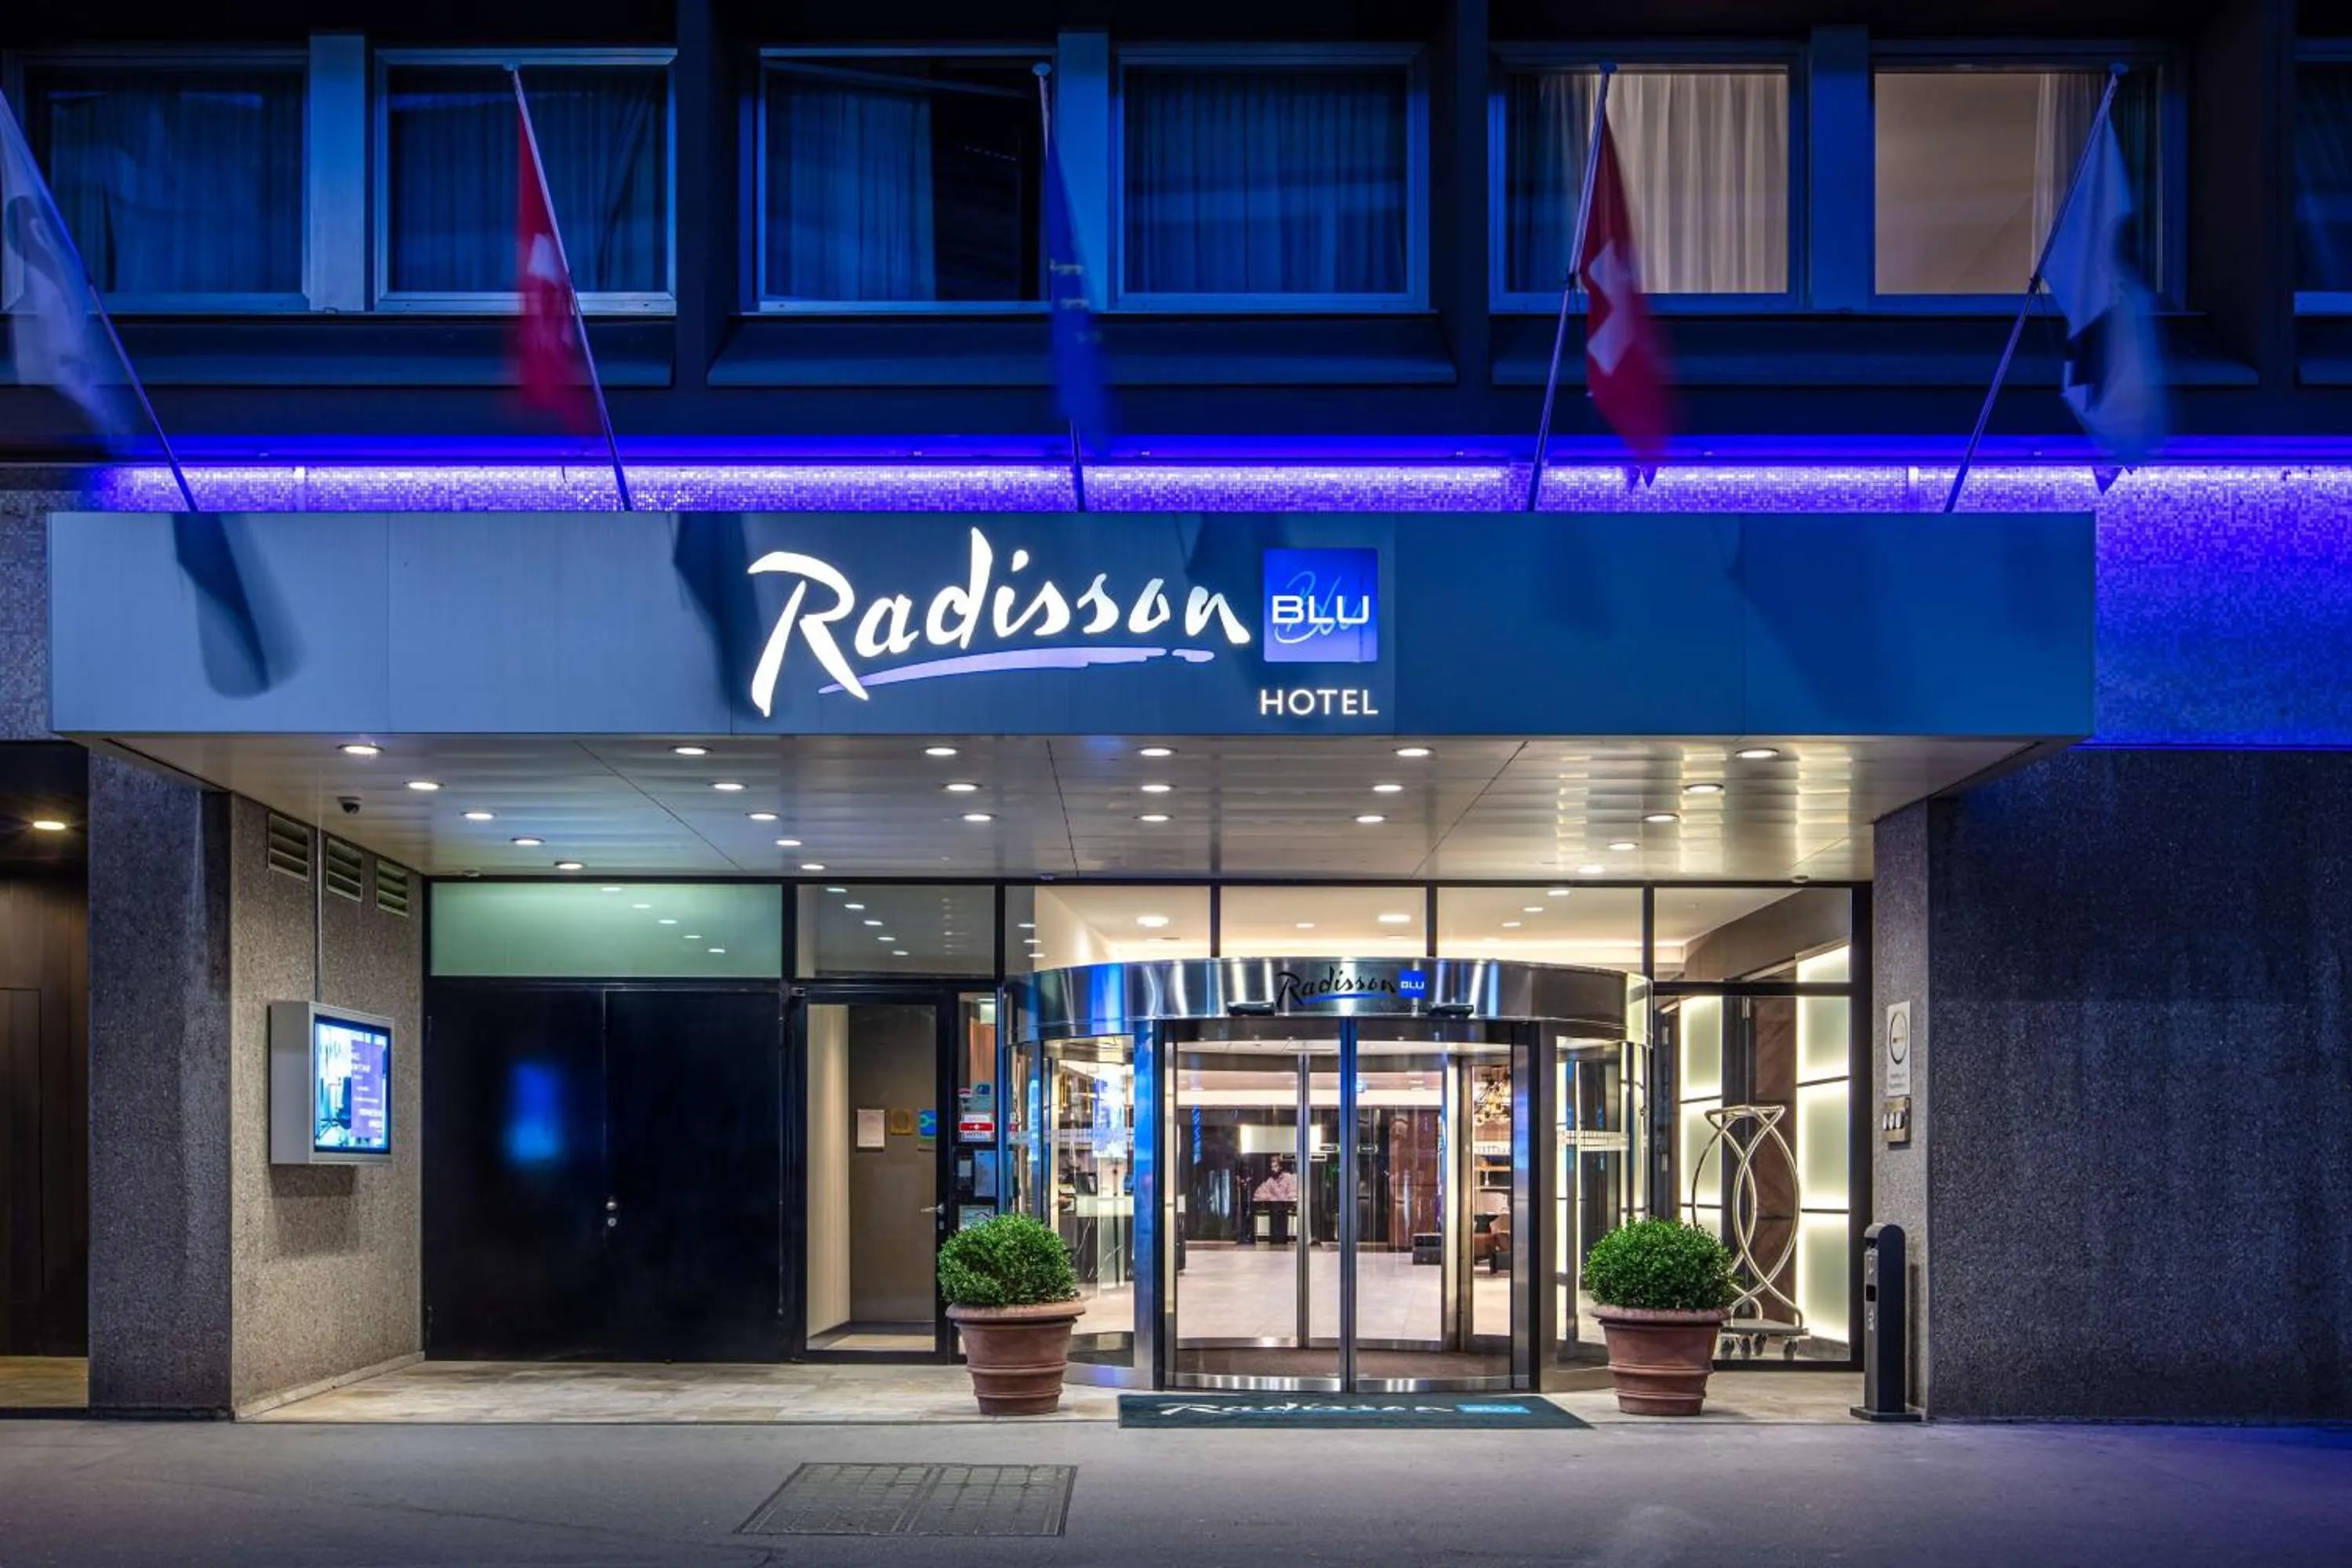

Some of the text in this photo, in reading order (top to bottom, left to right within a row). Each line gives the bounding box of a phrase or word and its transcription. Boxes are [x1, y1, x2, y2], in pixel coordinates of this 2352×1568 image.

[747, 527, 1370, 717] Radisson BLU
[1260, 689, 1379, 715] HOTEL
[1276, 965, 1396, 1008] Radisson
